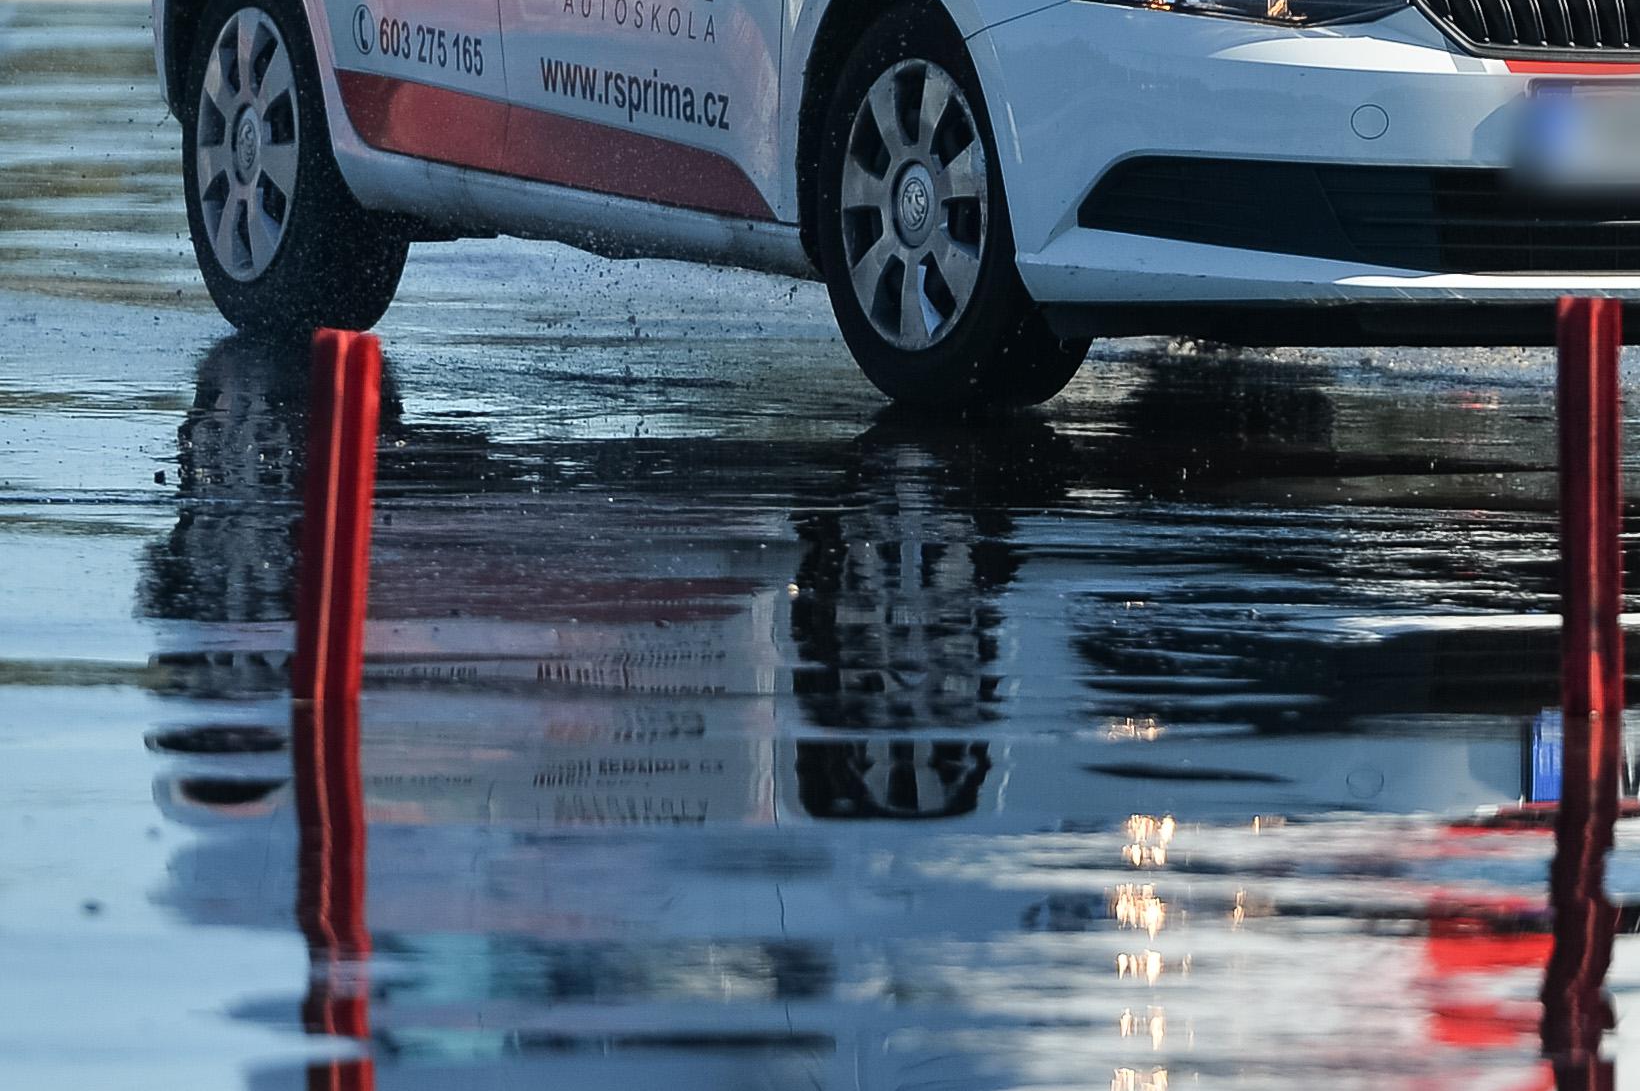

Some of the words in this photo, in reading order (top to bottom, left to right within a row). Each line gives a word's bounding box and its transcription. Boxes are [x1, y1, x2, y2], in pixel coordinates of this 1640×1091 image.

[379, 17, 412, 60] 603
[416, 24, 448, 68] 275
[452, 32, 484, 77] 165
[539, 56, 731, 131] www.rsprima.cz
